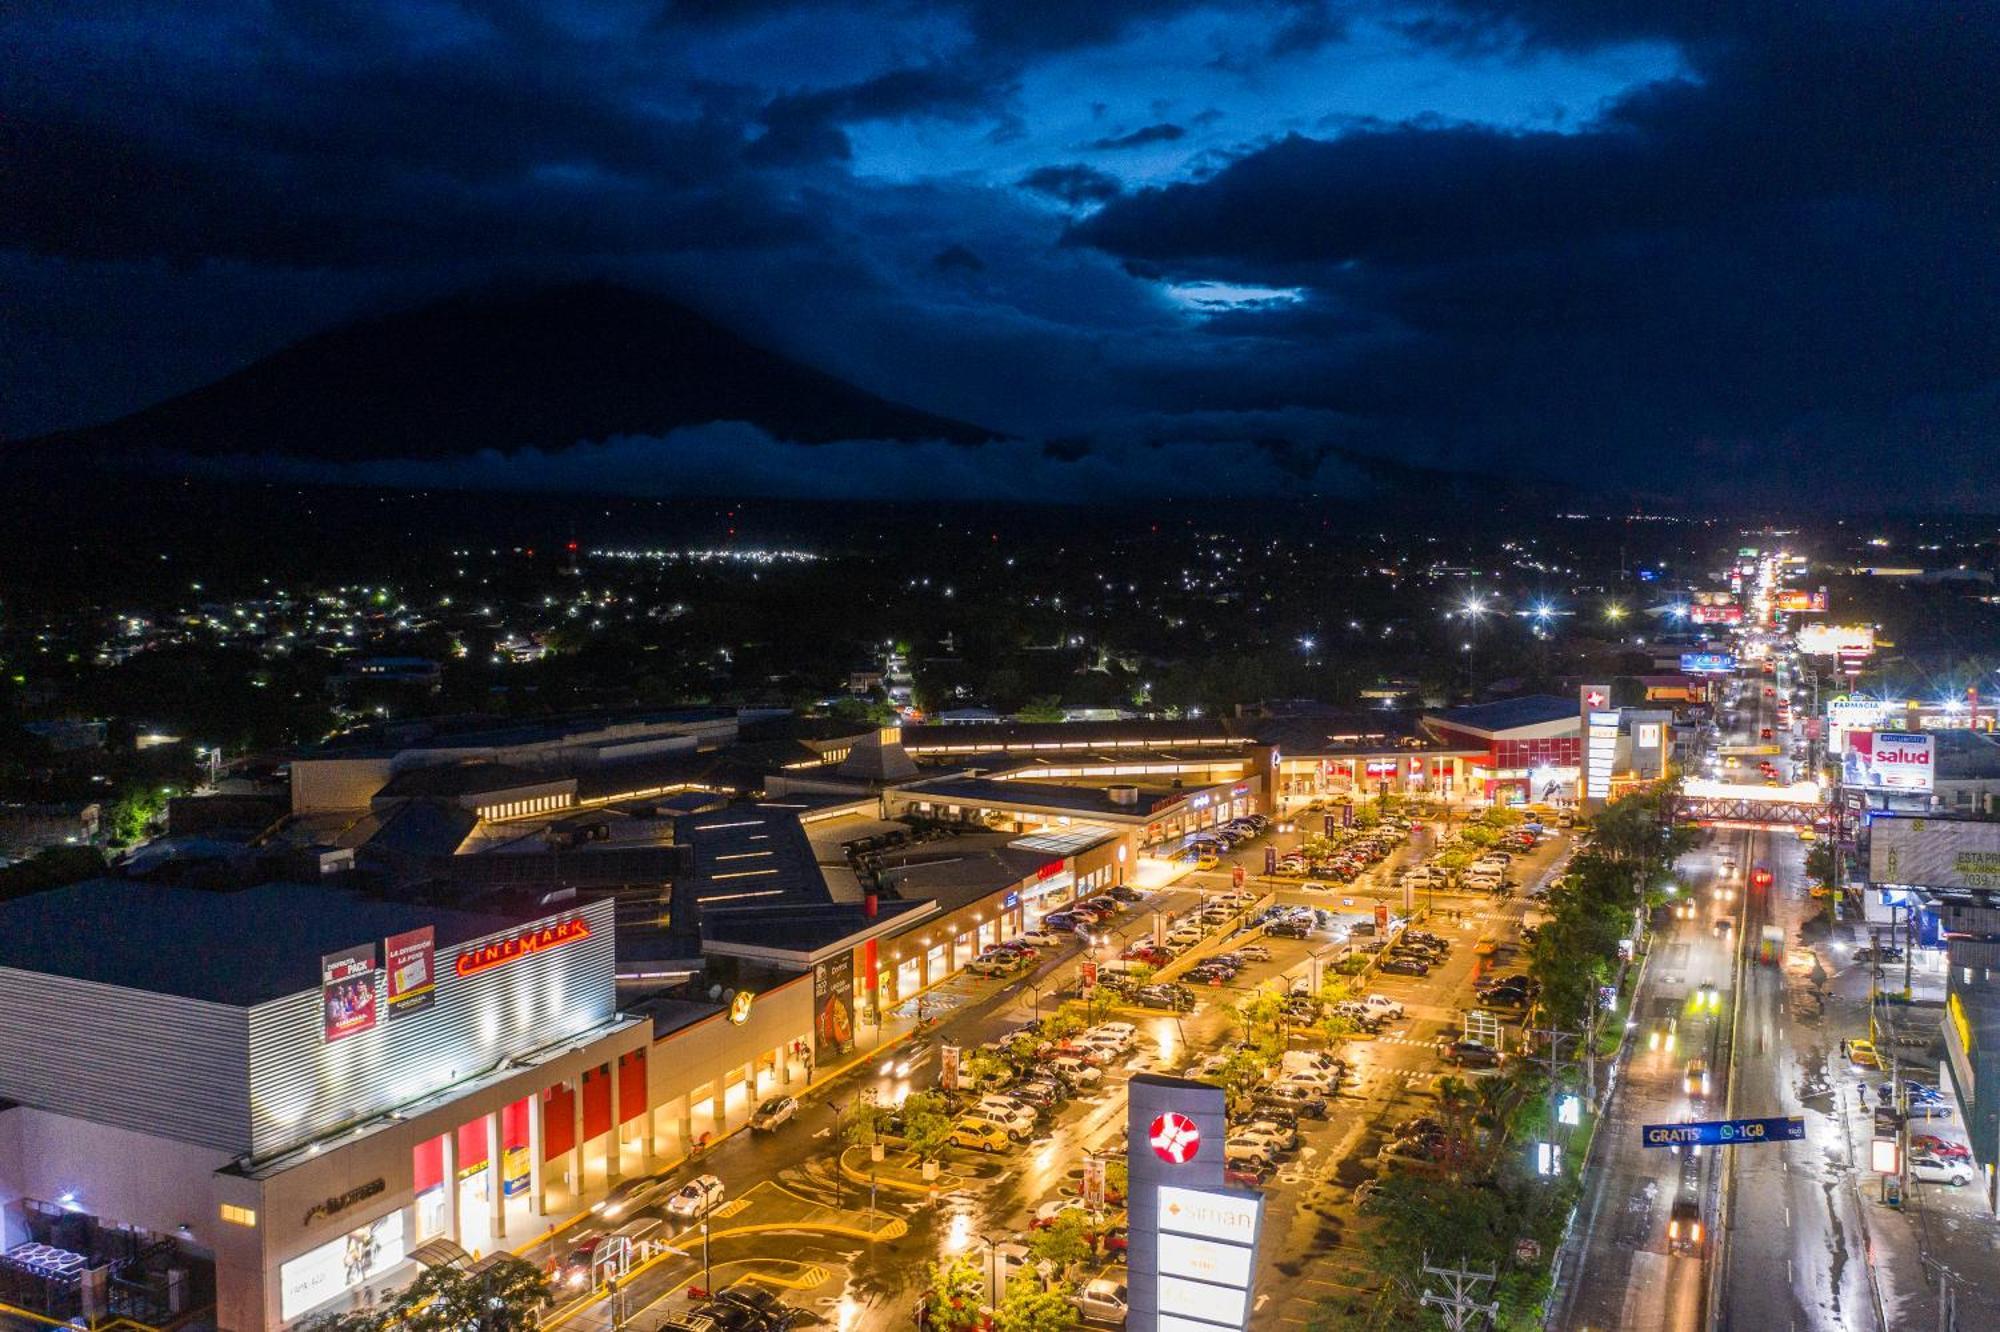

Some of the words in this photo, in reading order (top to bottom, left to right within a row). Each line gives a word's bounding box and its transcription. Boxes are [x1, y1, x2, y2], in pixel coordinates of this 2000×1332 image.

[1876, 748, 1930, 765] salud
[1958, 852, 1984, 863] ESTA
[1985, 852, 2000, 865] PR
[456, 918, 591, 976] CINEMARK
[1649, 1127, 1700, 1143] GRATIS
